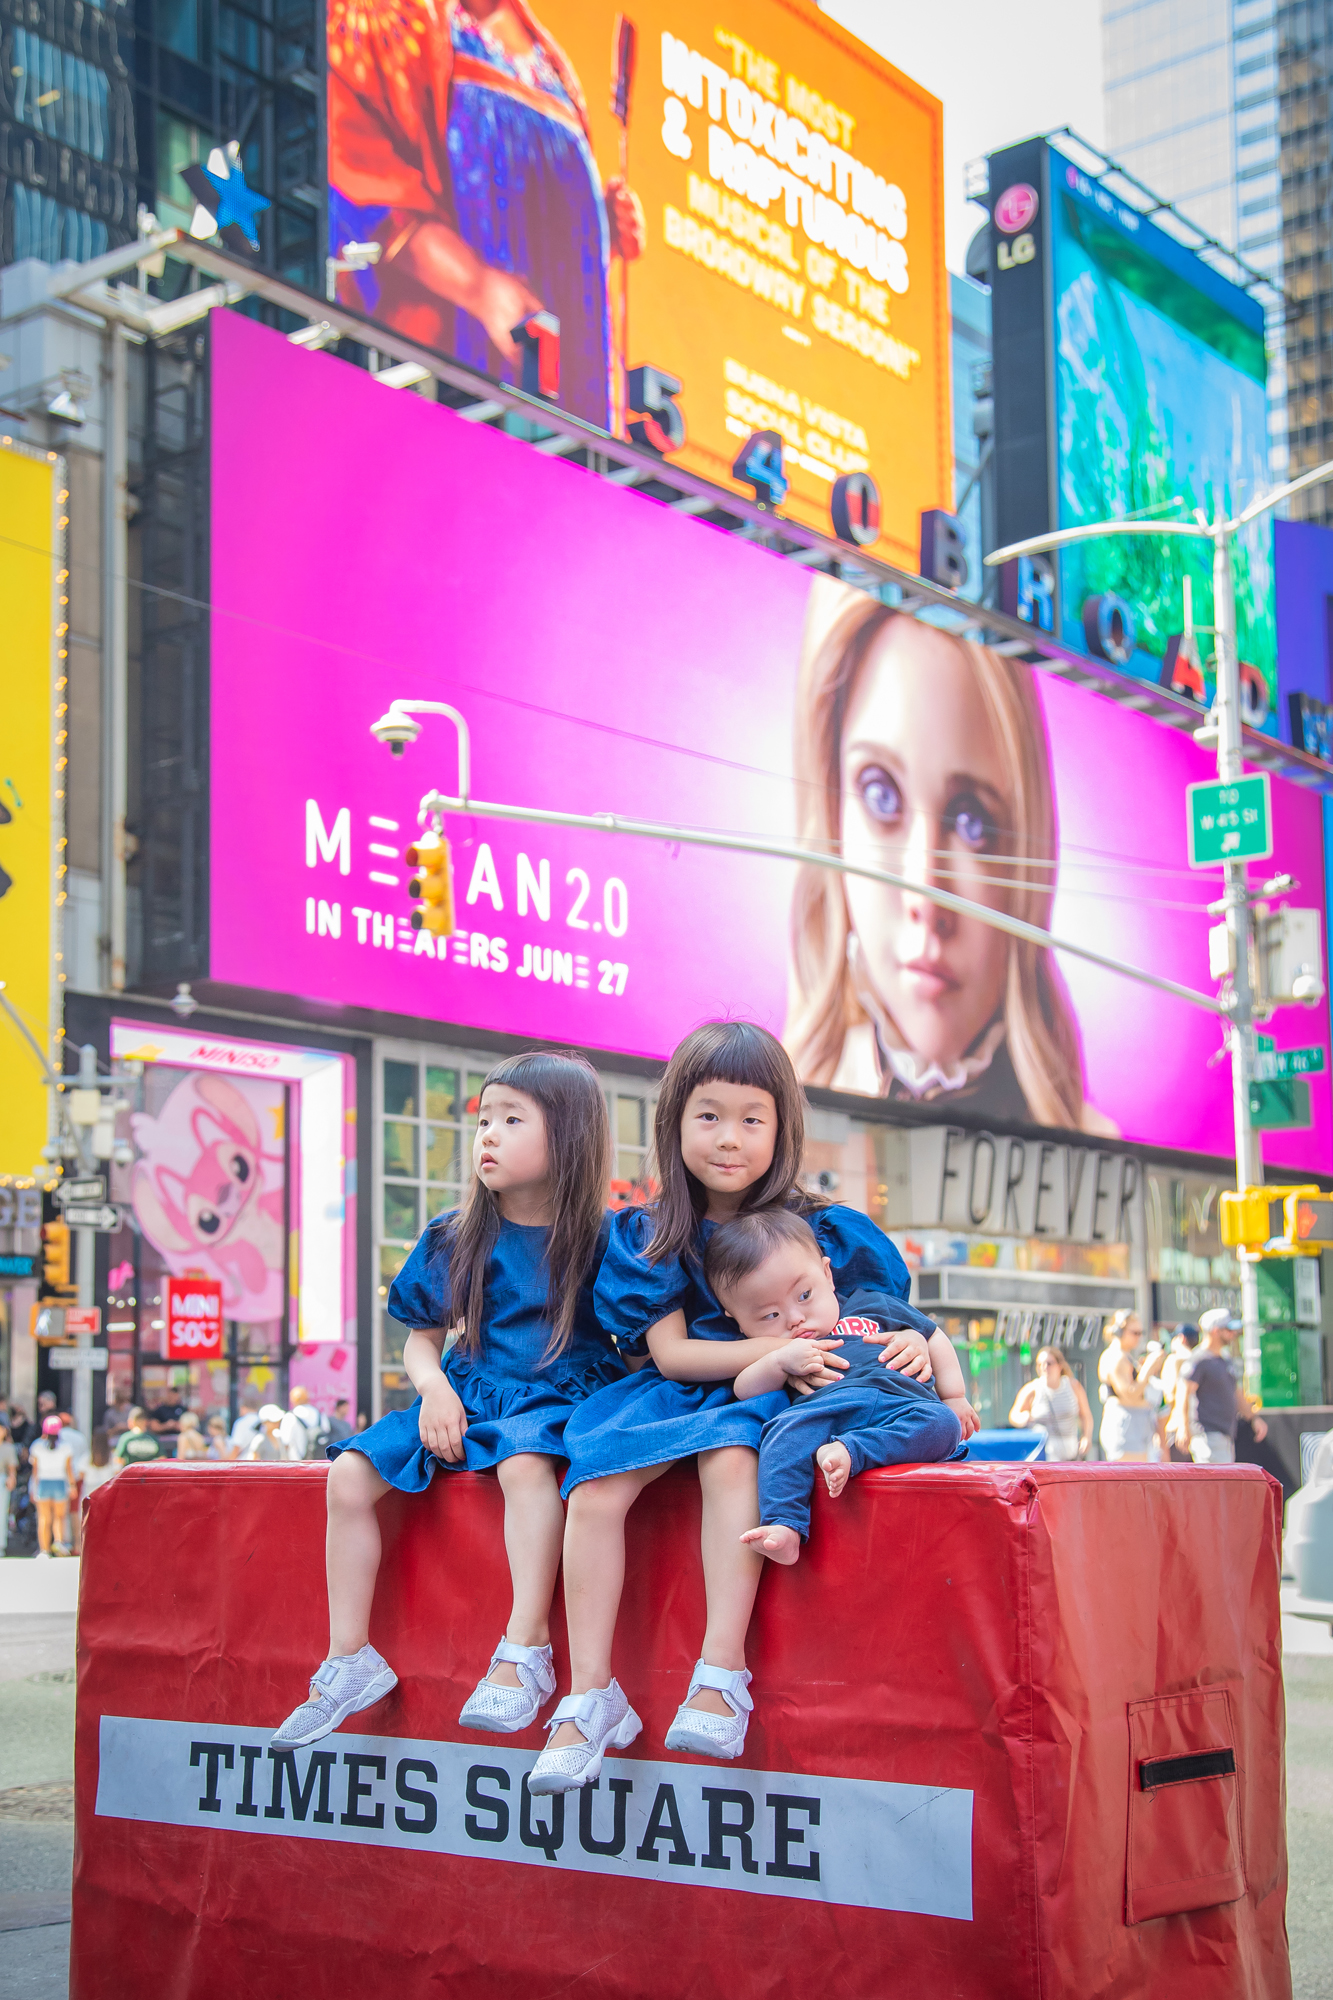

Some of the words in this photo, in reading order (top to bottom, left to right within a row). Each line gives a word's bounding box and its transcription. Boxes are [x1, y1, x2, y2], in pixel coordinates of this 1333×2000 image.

[785, 72, 857, 151] MOST
[661, 96, 693, 160] &
[708, 123, 909, 294] RAPTUROUS
[686, 169, 801, 274] MUSICAL
[804, 243, 839, 292] OF
[840, 265, 891, 328] THE
[997, 233, 1035, 270] LG
[663, 202, 807, 319] BROADWAY
[305, 798, 550, 922] MEAN
[566, 867, 628, 938] 2.0
[305, 897, 341, 939] IN
[516, 943, 590, 990] JUNE
[597, 960, 629, 996] 27
[188, 1044, 281, 1071] MINISO
[937, 1124, 1141, 1244] FOREVER
[171, 1292, 220, 1319] MINI
[189, 1741, 438, 1834] TIMES
[464, 1764, 821, 1882] SQUARE
